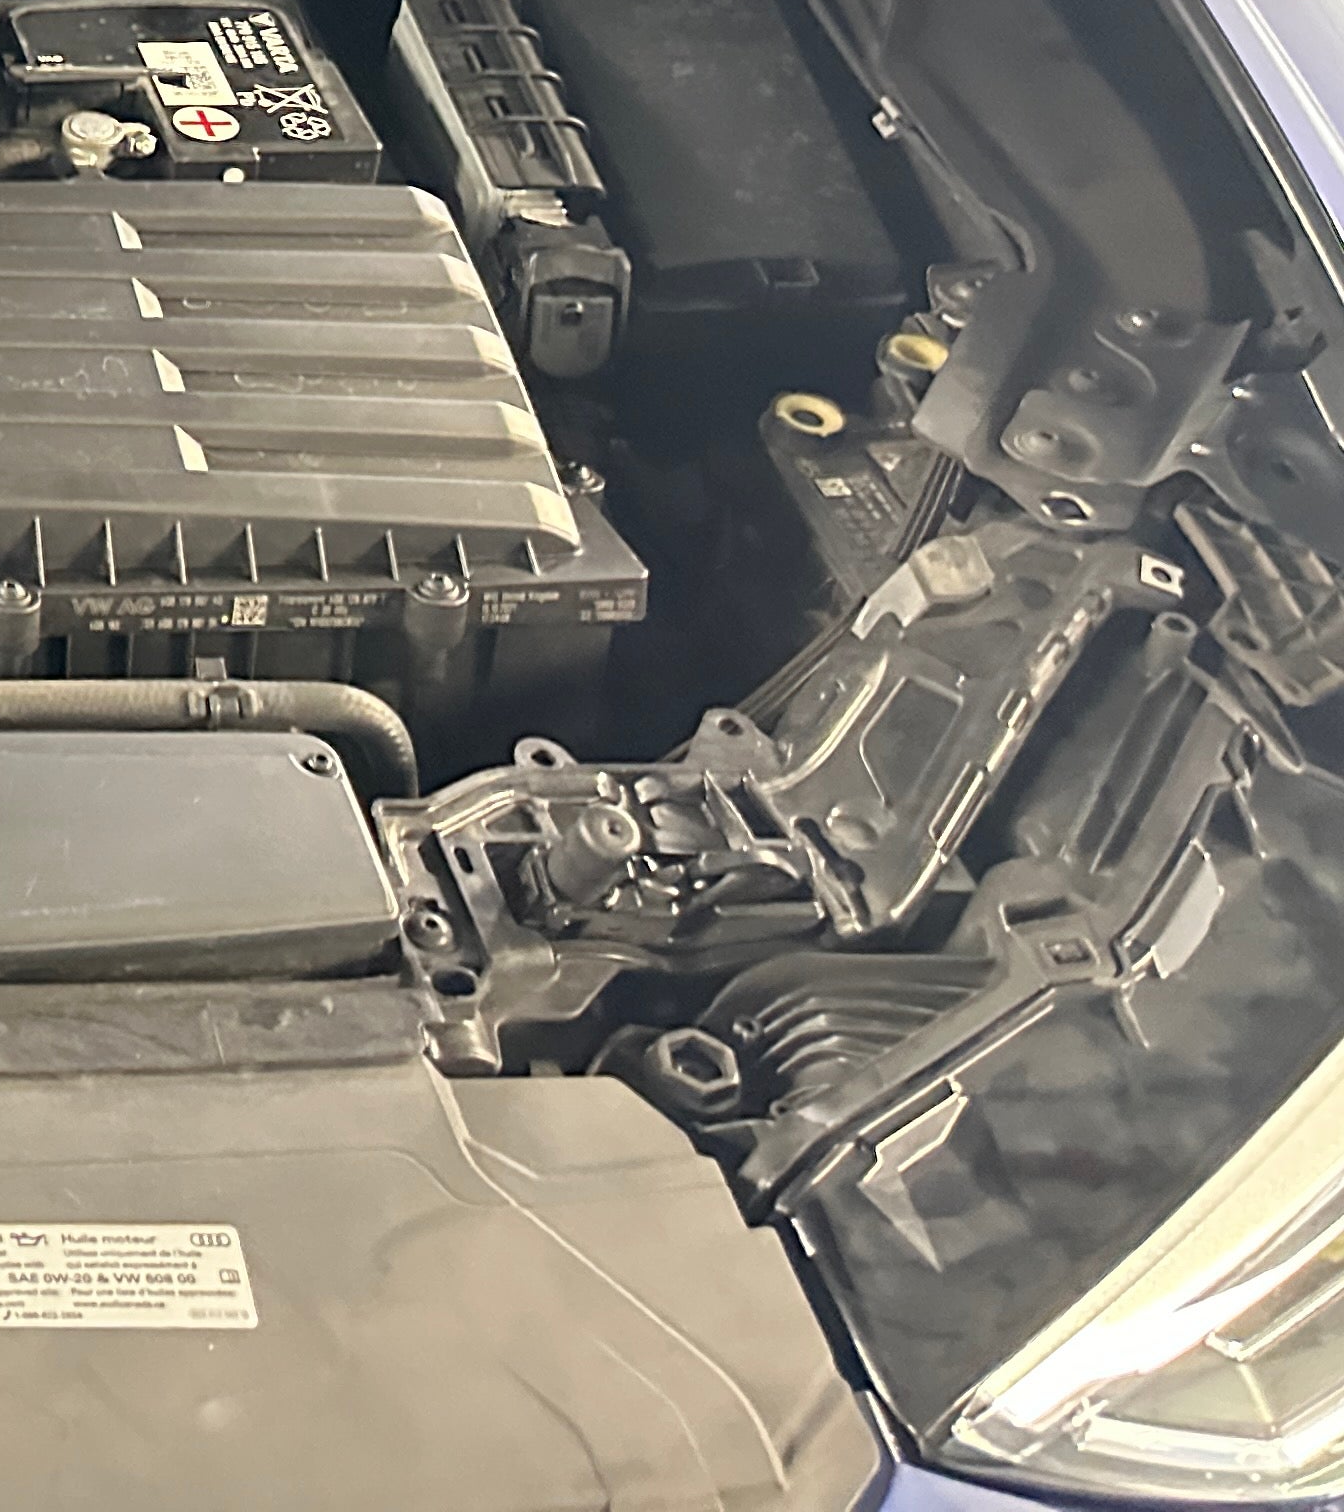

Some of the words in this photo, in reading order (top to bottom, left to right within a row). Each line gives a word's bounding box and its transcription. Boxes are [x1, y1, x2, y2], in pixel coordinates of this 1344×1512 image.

[259, 28, 299, 74] VARTA
[71, 597, 114, 616] VW
[117, 596, 156, 615] AG
[61, 1233, 98, 1244] Huile
[102, 1234, 156, 1244] moteur
[8, 1272, 39, 1284] SAE
[43, 1272, 92, 1284] 0W-20
[97, 1272, 109, 1284] &
[113, 1272, 141, 1284] VW
